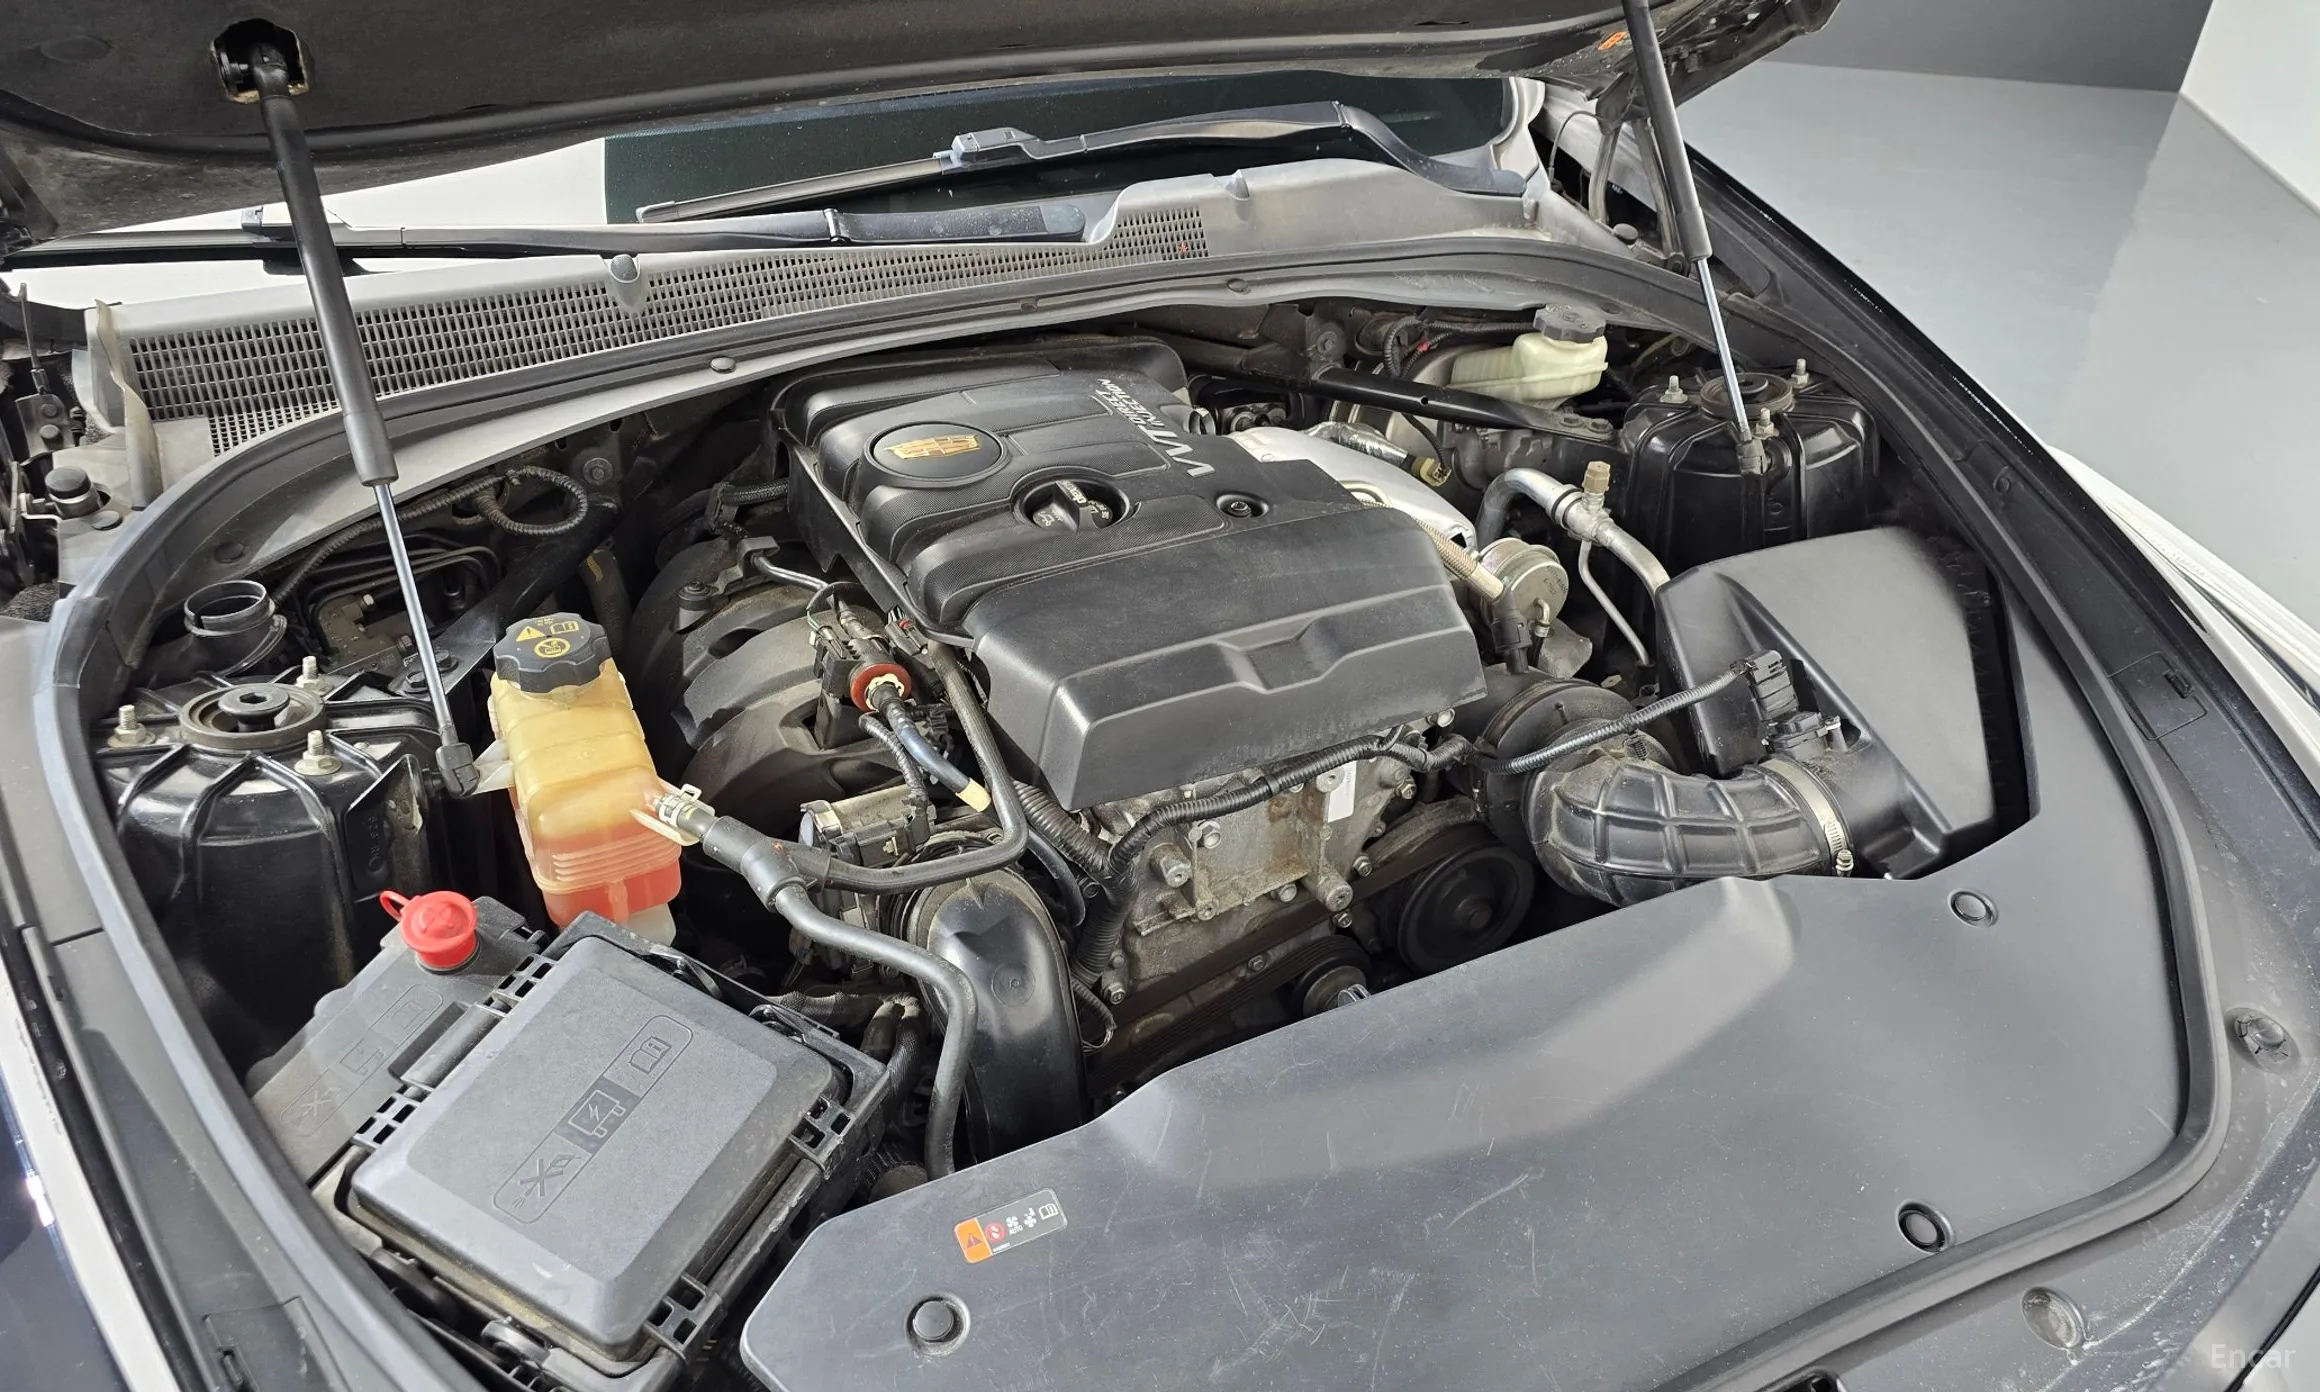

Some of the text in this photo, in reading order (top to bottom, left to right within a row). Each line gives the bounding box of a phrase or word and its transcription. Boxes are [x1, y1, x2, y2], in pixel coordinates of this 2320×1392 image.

[1095, 389, 1147, 425] DIRECT
[1097, 378, 1165, 427] INJECTION
[1137, 426, 1215, 477] VVT
[1009, 1225, 1023, 1235] AUTO
